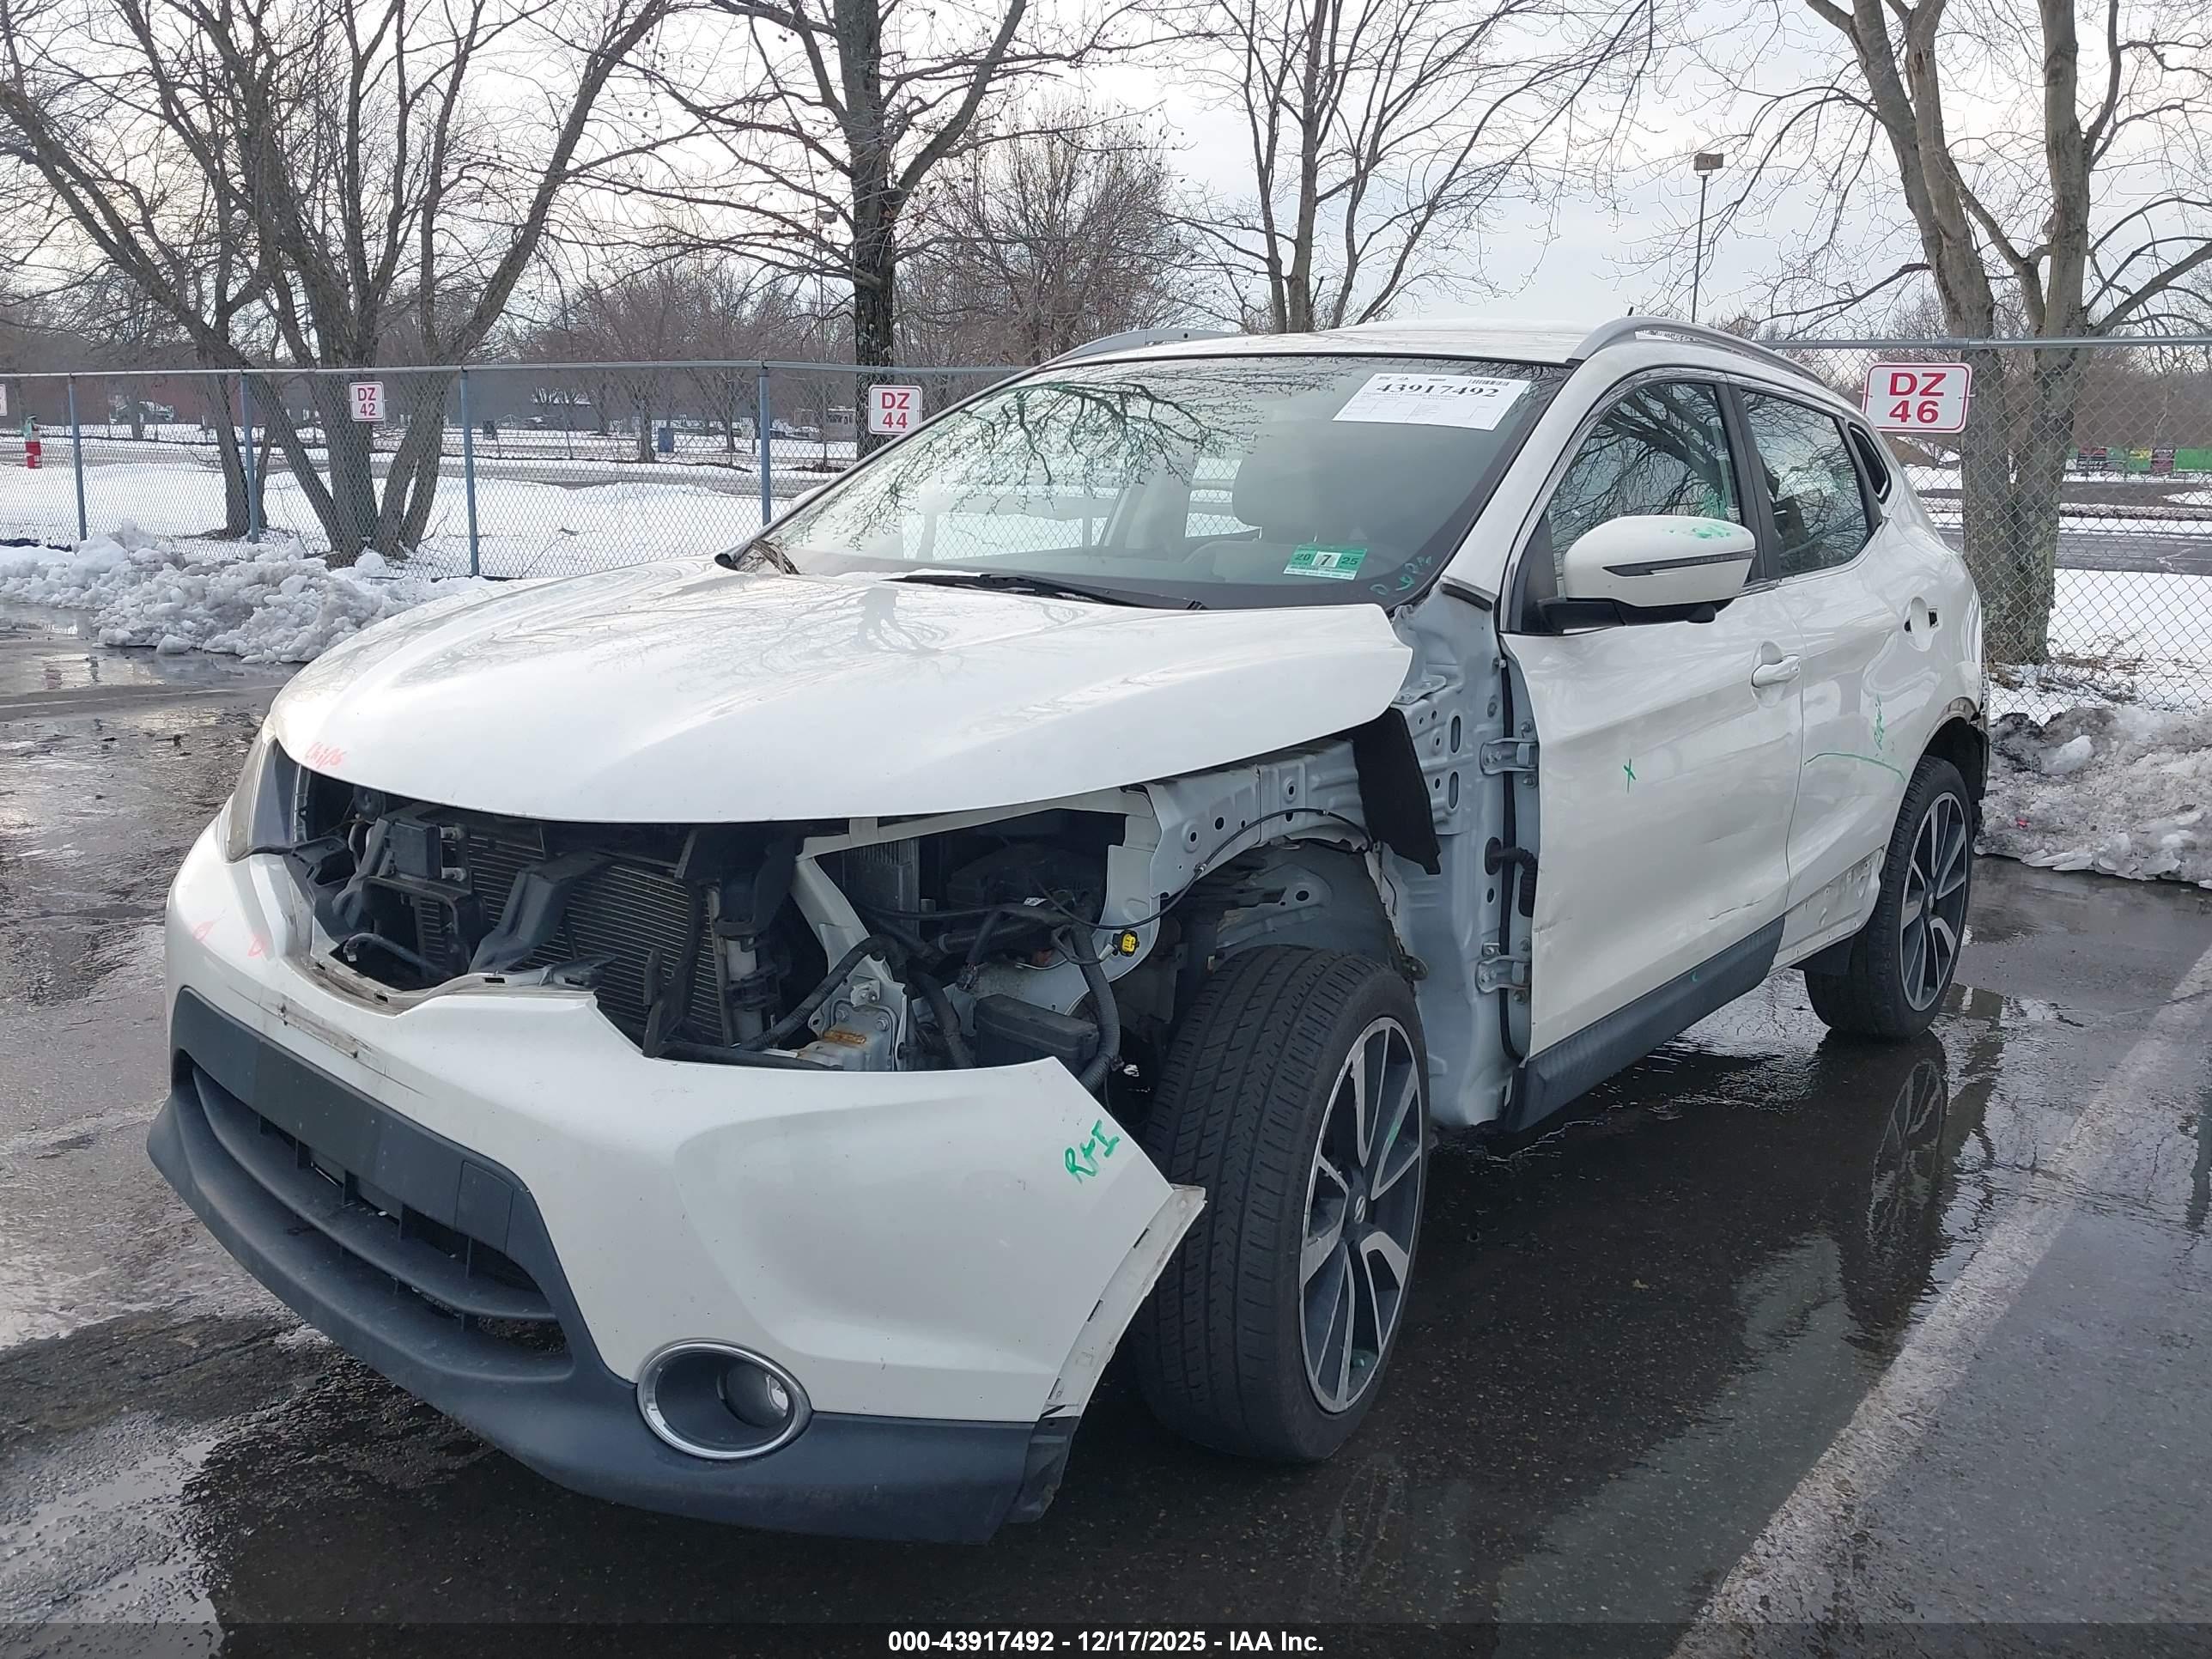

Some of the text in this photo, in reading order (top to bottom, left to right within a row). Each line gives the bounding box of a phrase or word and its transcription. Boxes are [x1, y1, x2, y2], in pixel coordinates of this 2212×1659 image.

[1376, 383, 1499, 398] 43917492
[1889, 372, 1947, 398] DZ
[357, 387, 376, 401] DZ
[881, 392, 910, 410] DZ
[360, 403, 376, 416] 42
[1889, 400, 1939, 423] 46
[882, 412, 908, 428] 44
[1295, 553, 1311, 562] 20
[1321, 555, 1332, 566] 7
